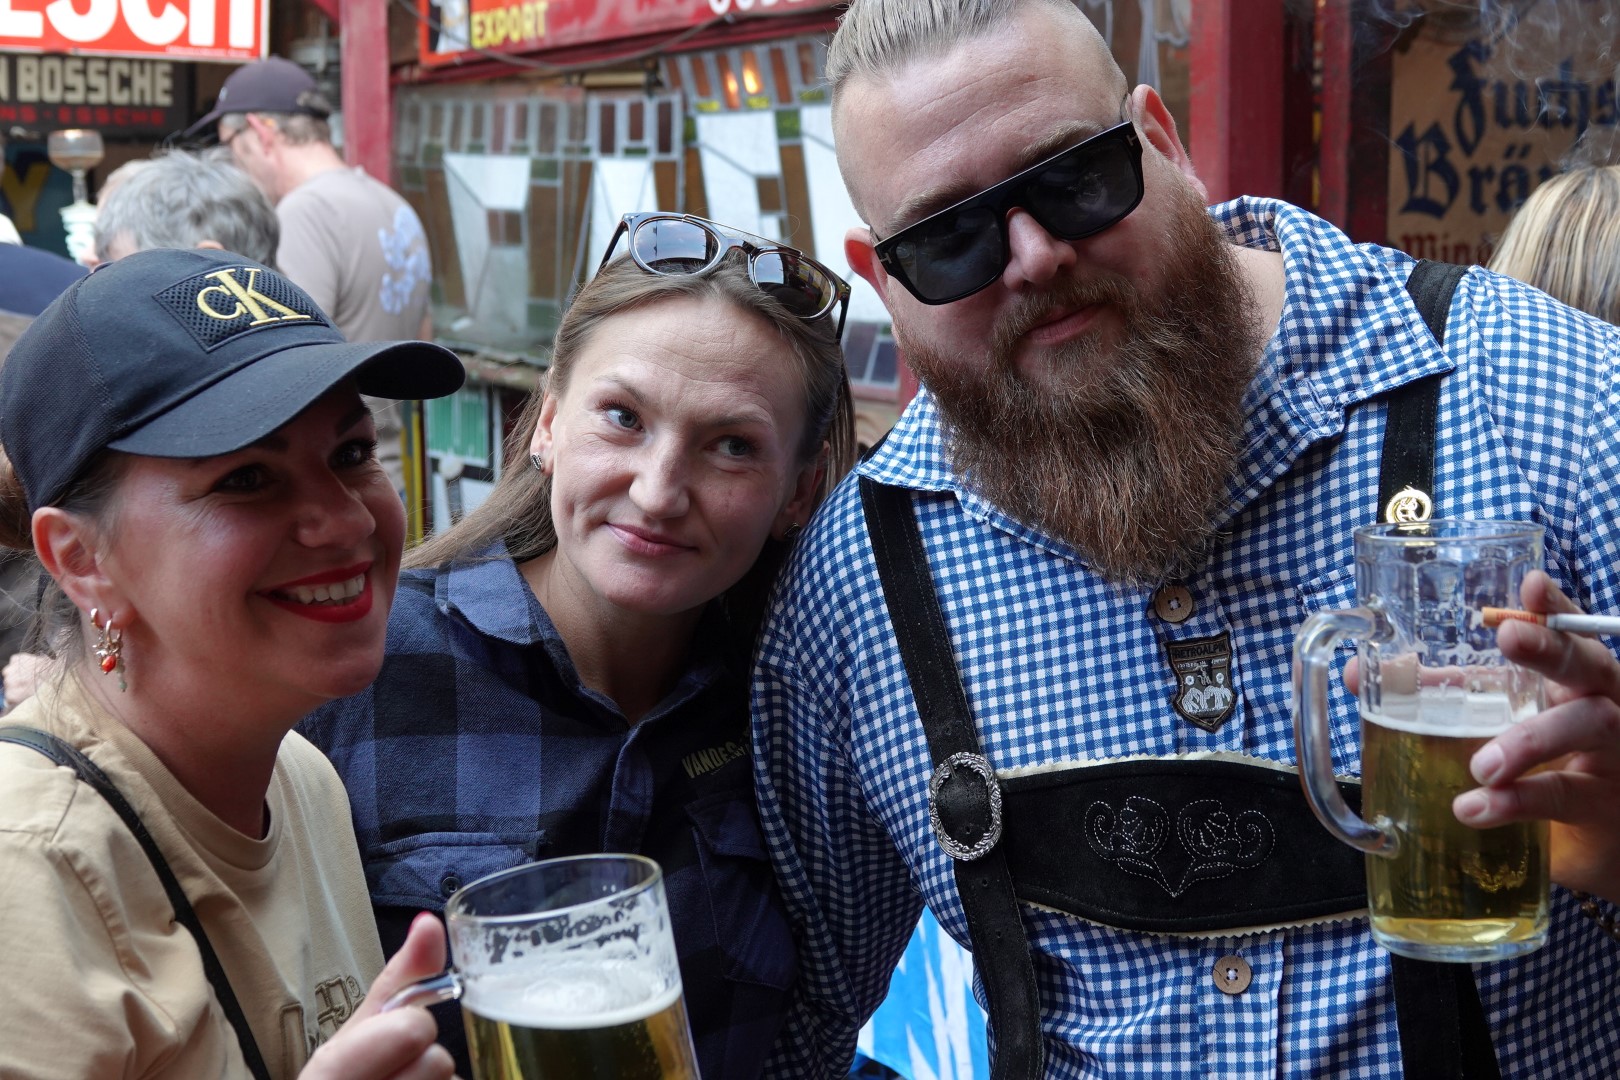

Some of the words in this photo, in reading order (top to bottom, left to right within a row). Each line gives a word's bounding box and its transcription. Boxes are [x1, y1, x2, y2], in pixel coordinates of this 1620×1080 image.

[471, 2, 547, 48] EXPORT
[17, 56, 173, 106] BOSSCHE
[1396, 122, 1556, 220] Brä
